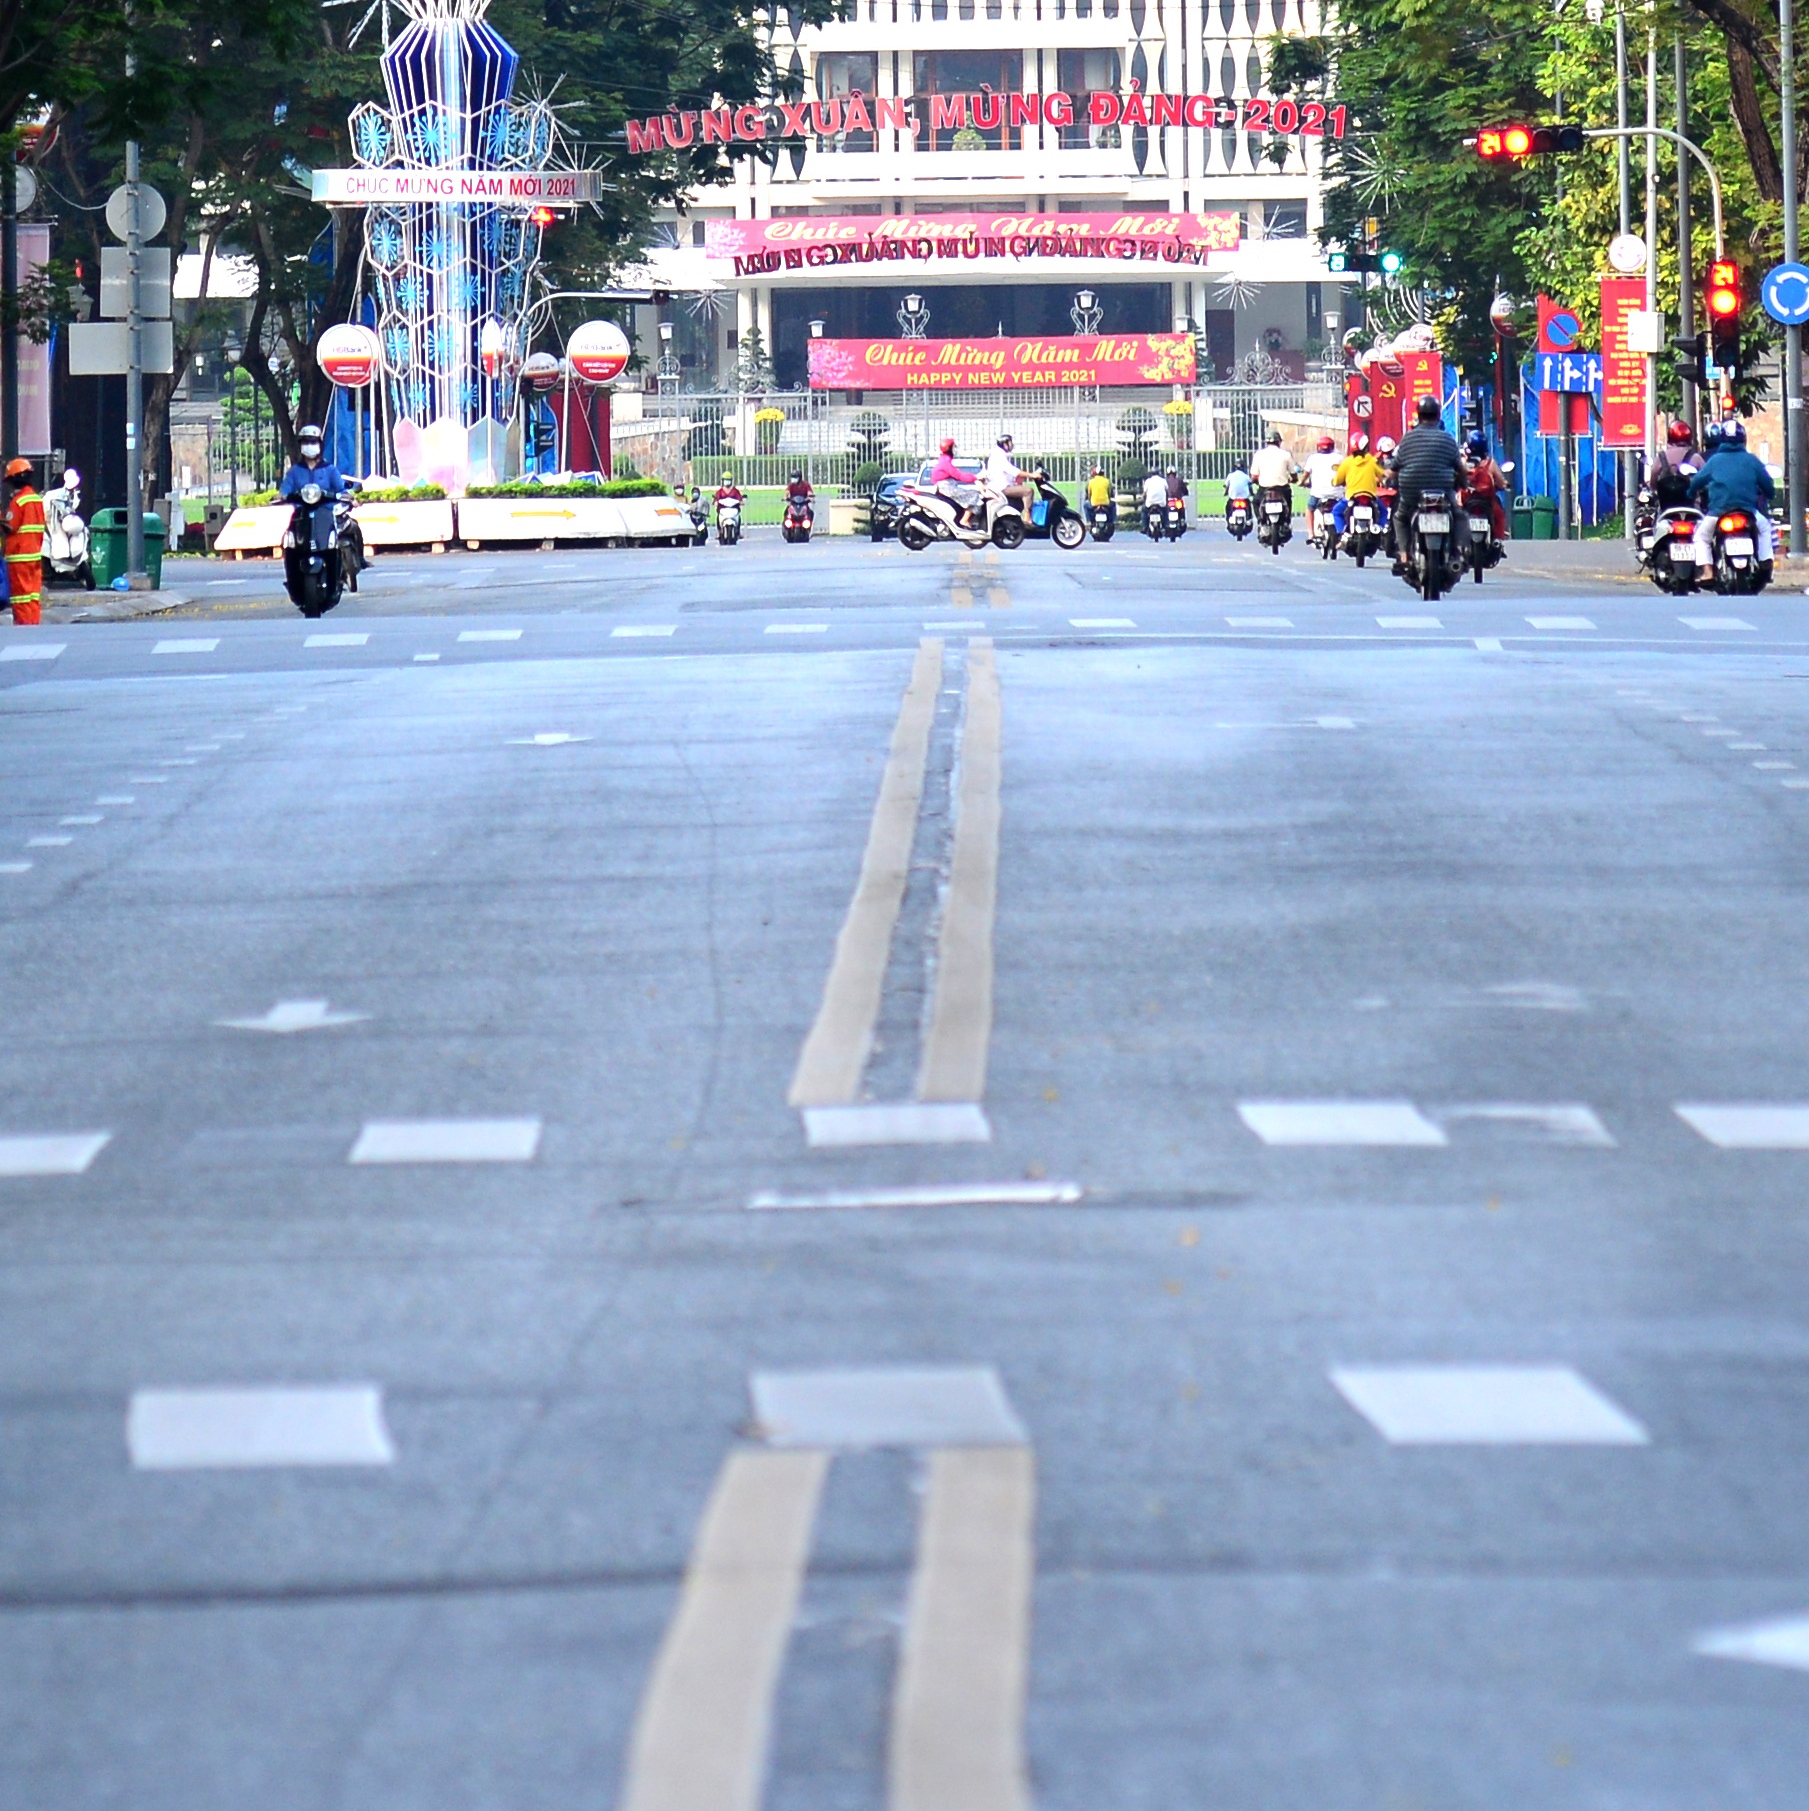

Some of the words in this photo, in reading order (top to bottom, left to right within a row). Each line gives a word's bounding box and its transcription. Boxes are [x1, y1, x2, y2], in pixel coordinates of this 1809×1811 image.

[625, 103, 766, 154] MỪNG
[780, 88, 921, 137] XUÂN,
[931, 82, 1074, 129] MỪNG
[1243, 98, 1347, 139] 2021
[460, 174, 503, 195] NĂM
[509, 173, 542, 196] MỚI
[547, 178, 576, 195] 2021
[763, 219, 856, 240] Chúc
[865, 217, 978, 240] Mừng
[990, 215, 1093, 237] Năm
[1099, 214, 1181, 237] Mới
[864, 343, 926, 366] Chúc
[931, 342, 1007, 369] Mừng
[1013, 340, 1083, 365] Năm
[1084, 339, 1140, 364] Mới
[906, 373, 962, 386] HAPPY
[968, 372, 1005, 385] NEW
[1011, 371, 1057, 384] YEAR
[1061, 370, 1097, 383] 2021
